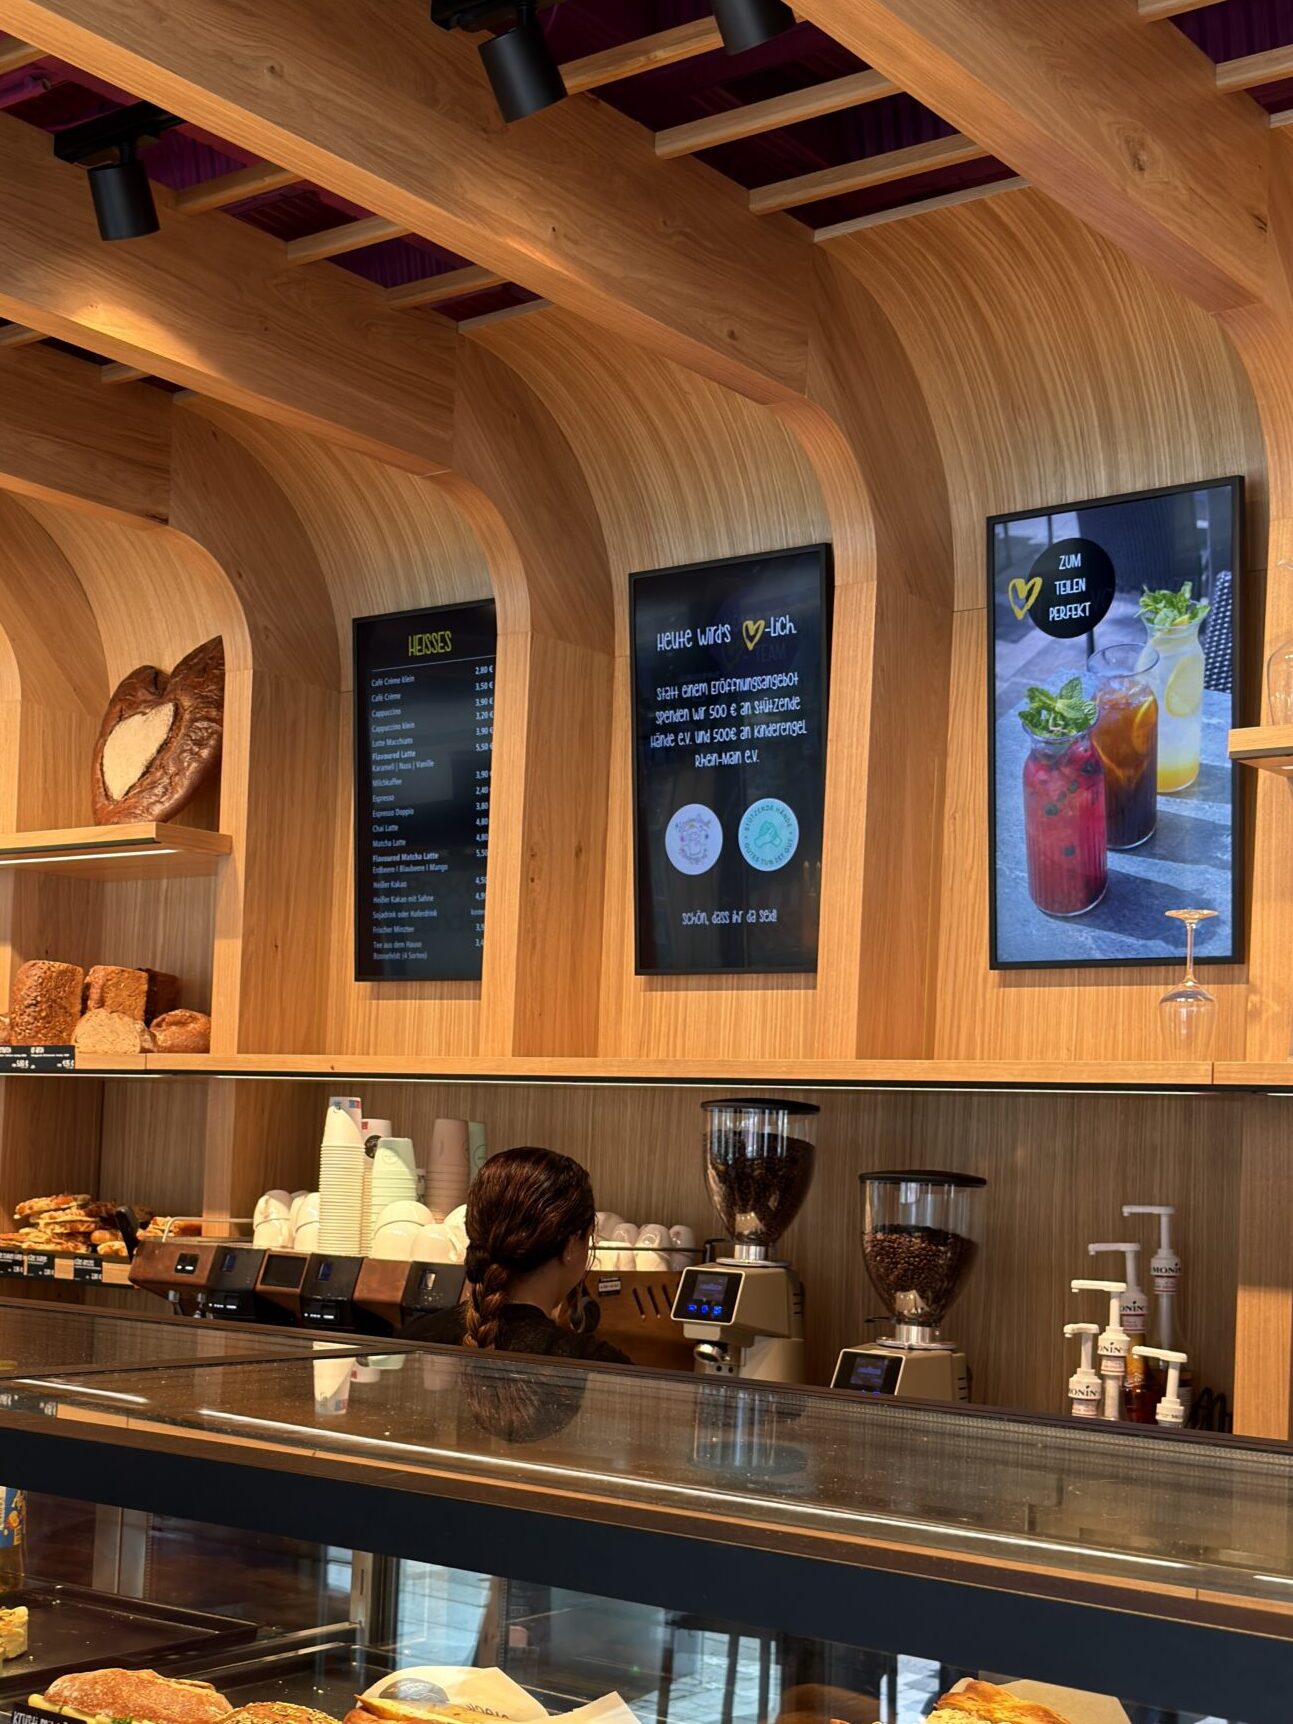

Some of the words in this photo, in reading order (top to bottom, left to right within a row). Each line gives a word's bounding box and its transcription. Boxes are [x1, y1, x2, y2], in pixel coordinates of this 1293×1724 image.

[1058, 553, 1081, 570] ZUM
[1054, 577, 1087, 596] TEILEN
[1049, 601, 1092, 621] PERFEKT
[408, 630, 452, 657] HEISSES
[709, 704, 728, 719] 500
[740, 701, 752, 716] an
[740, 726, 752, 740] an
[1119, 1300, 1145, 1312] ONIN
[1068, 1384, 1098, 1397] ONIN
